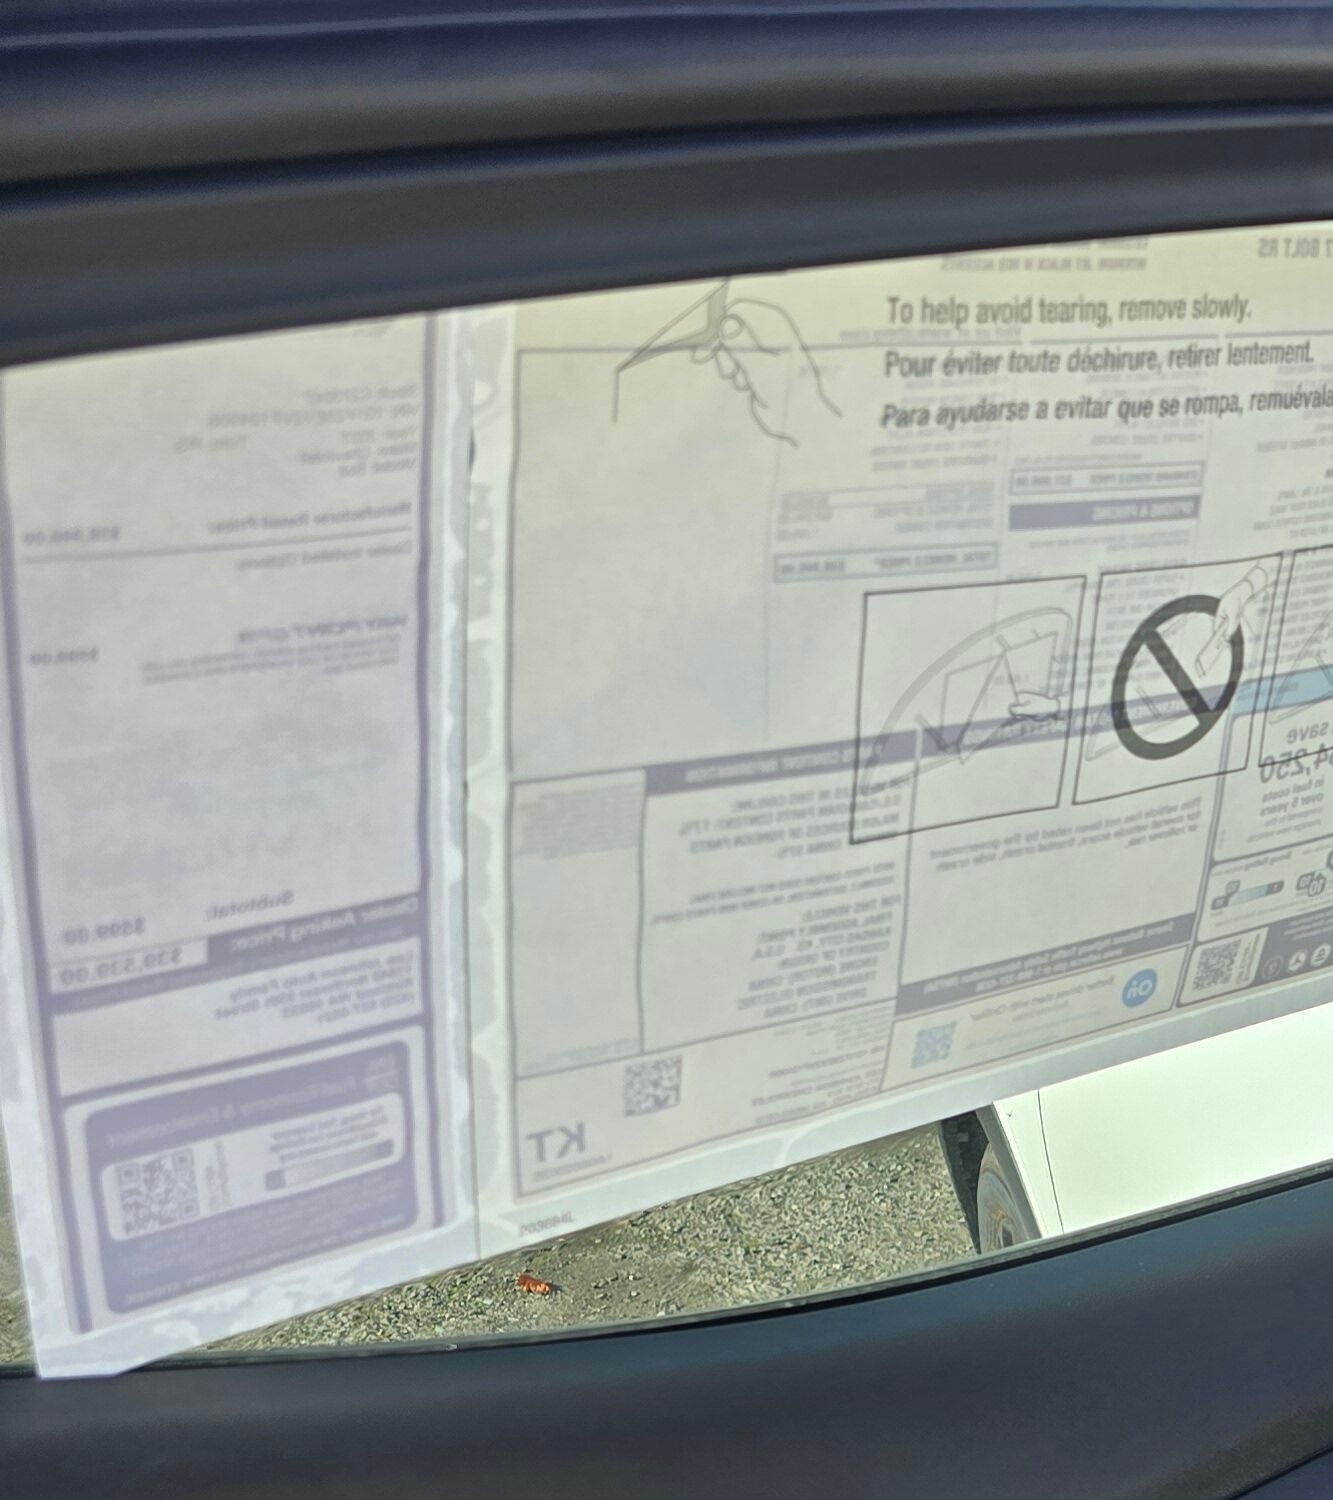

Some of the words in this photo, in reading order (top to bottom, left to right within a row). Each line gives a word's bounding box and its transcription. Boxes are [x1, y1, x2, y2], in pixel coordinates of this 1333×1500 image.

[887, 296, 913, 323] To
[921, 296, 969, 330] help
[975, 296, 1032, 323] avoid
[1039, 295, 1112, 329] tearing,
[1118, 297, 1187, 321] remove
[1191, 293, 1252, 324] slowly.
[885, 350, 936, 378] Pour
[942, 347, 1003, 376] éviter
[1008, 350, 1060, 373] toute
[1066, 344, 1162, 374] déchirure,
[1167, 344, 1222, 369] retirer
[1227, 339, 1314, 365] lentement.
[880, 404, 930, 429] Para
[936, 397, 1031, 431] ayudarse
[1035, 399, 1048, 420] a
[1054, 395, 1112, 420] evitar
[1117, 398, 1153, 424] que
[1159, 397, 1180, 418] se
[1184, 394, 1243, 419] rompa,
